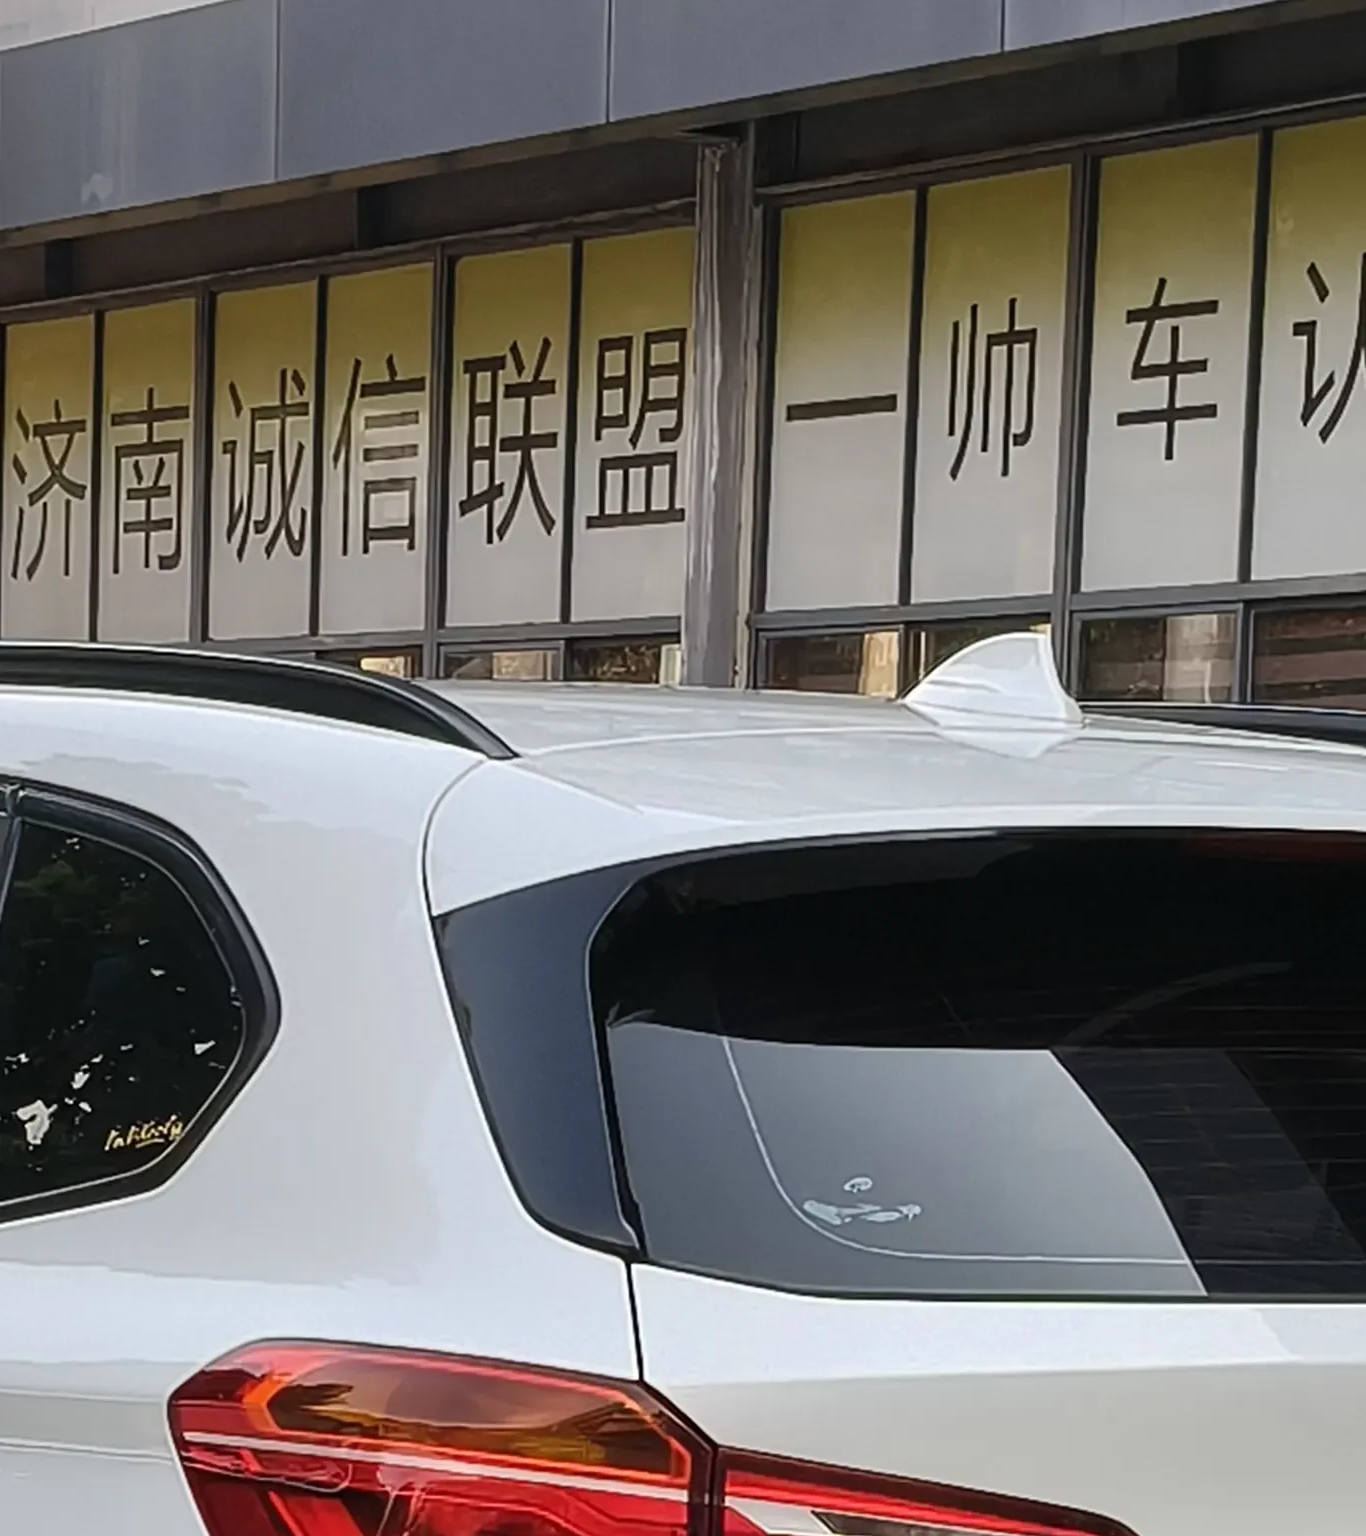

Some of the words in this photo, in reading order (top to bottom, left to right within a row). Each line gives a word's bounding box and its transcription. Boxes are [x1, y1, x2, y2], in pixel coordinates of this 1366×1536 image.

[11, 328, 687, 580] 济南诚信联盟
